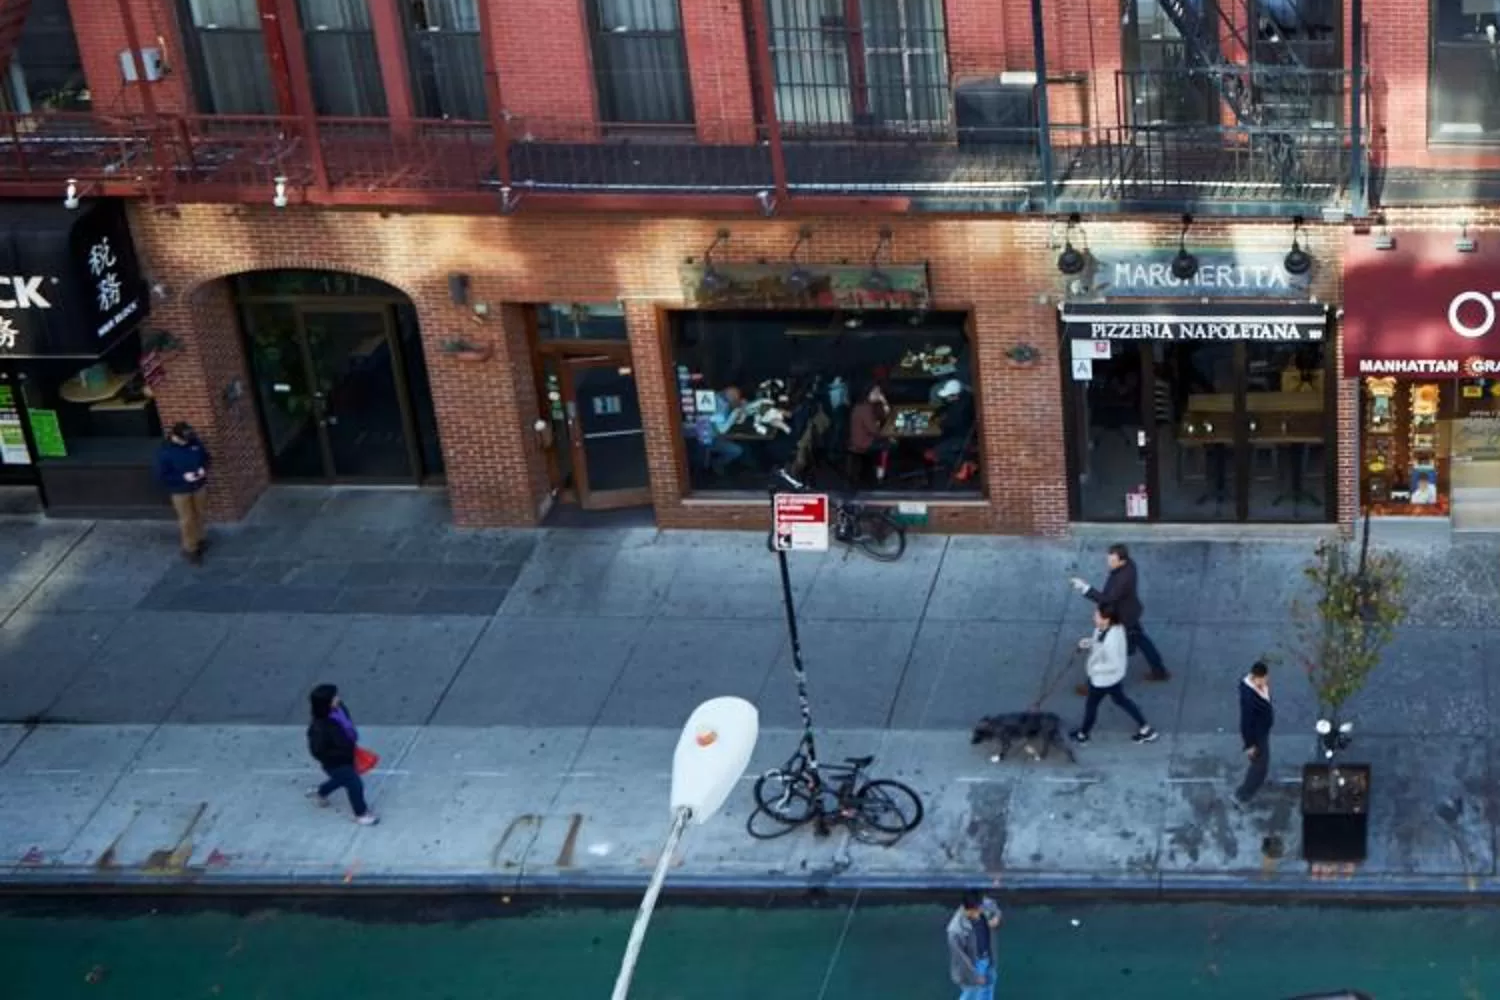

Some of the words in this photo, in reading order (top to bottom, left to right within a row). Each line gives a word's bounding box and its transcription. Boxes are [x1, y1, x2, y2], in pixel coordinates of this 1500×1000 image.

[1090, 323, 1174, 340] PIZZERIA
[1179, 323, 1301, 340] NAPOLETANA
[1359, 359, 1459, 373] MANHATTAN
